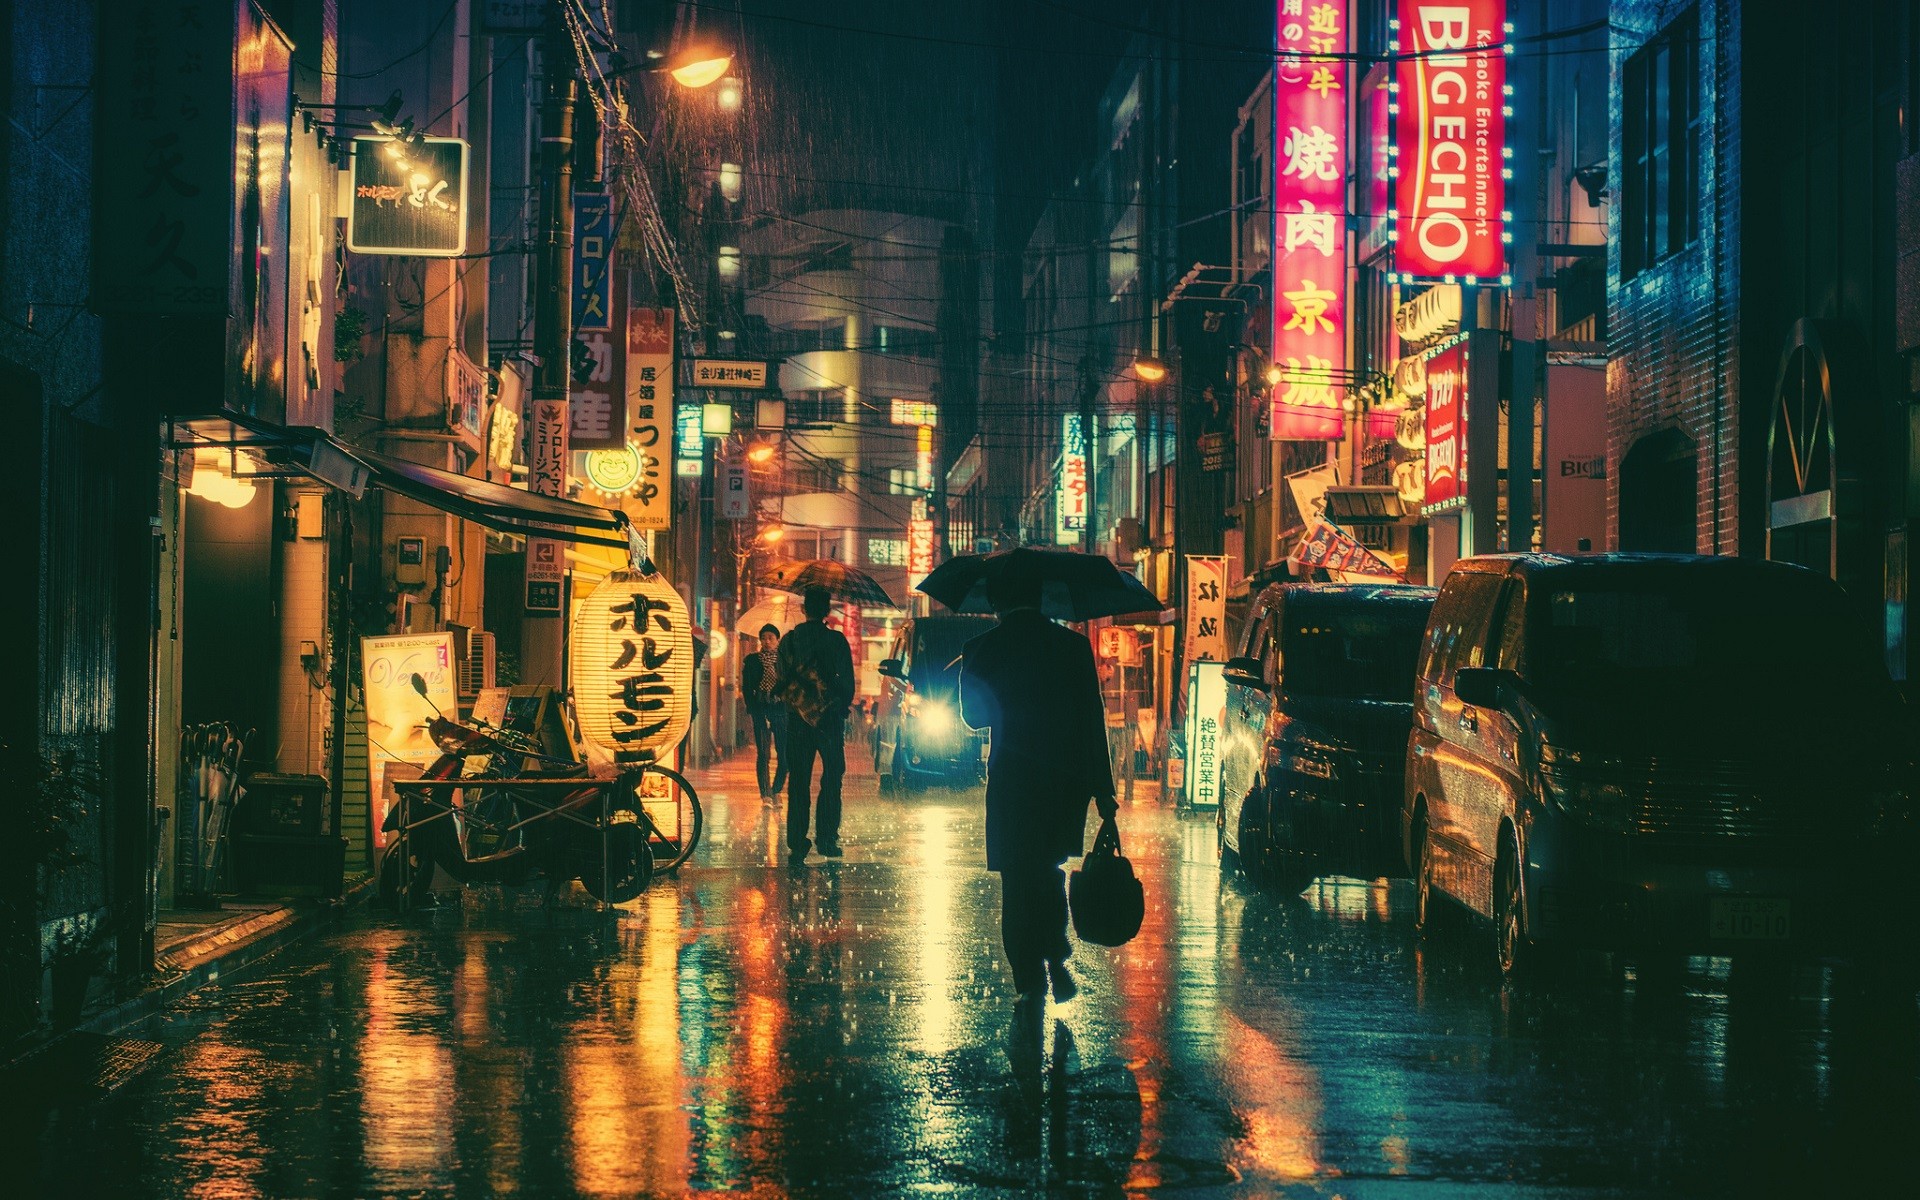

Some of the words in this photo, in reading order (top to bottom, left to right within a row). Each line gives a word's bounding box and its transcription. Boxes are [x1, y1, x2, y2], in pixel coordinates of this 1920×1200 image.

[1307, 3, 1341, 99] 近江牛
[1418, 6, 1470, 104] BIG
[1476, 29, 1492, 100] Karaoke
[1418, 116, 1469, 262] ECHO
[1475, 107, 1491, 236] Entertainment
[581, 203, 607, 319] プロレス
[639, 367, 656, 419] 居酒屋
[608, 593, 674, 743] ホルモン
[1199, 717, 1217, 802] 絶賛営業中
